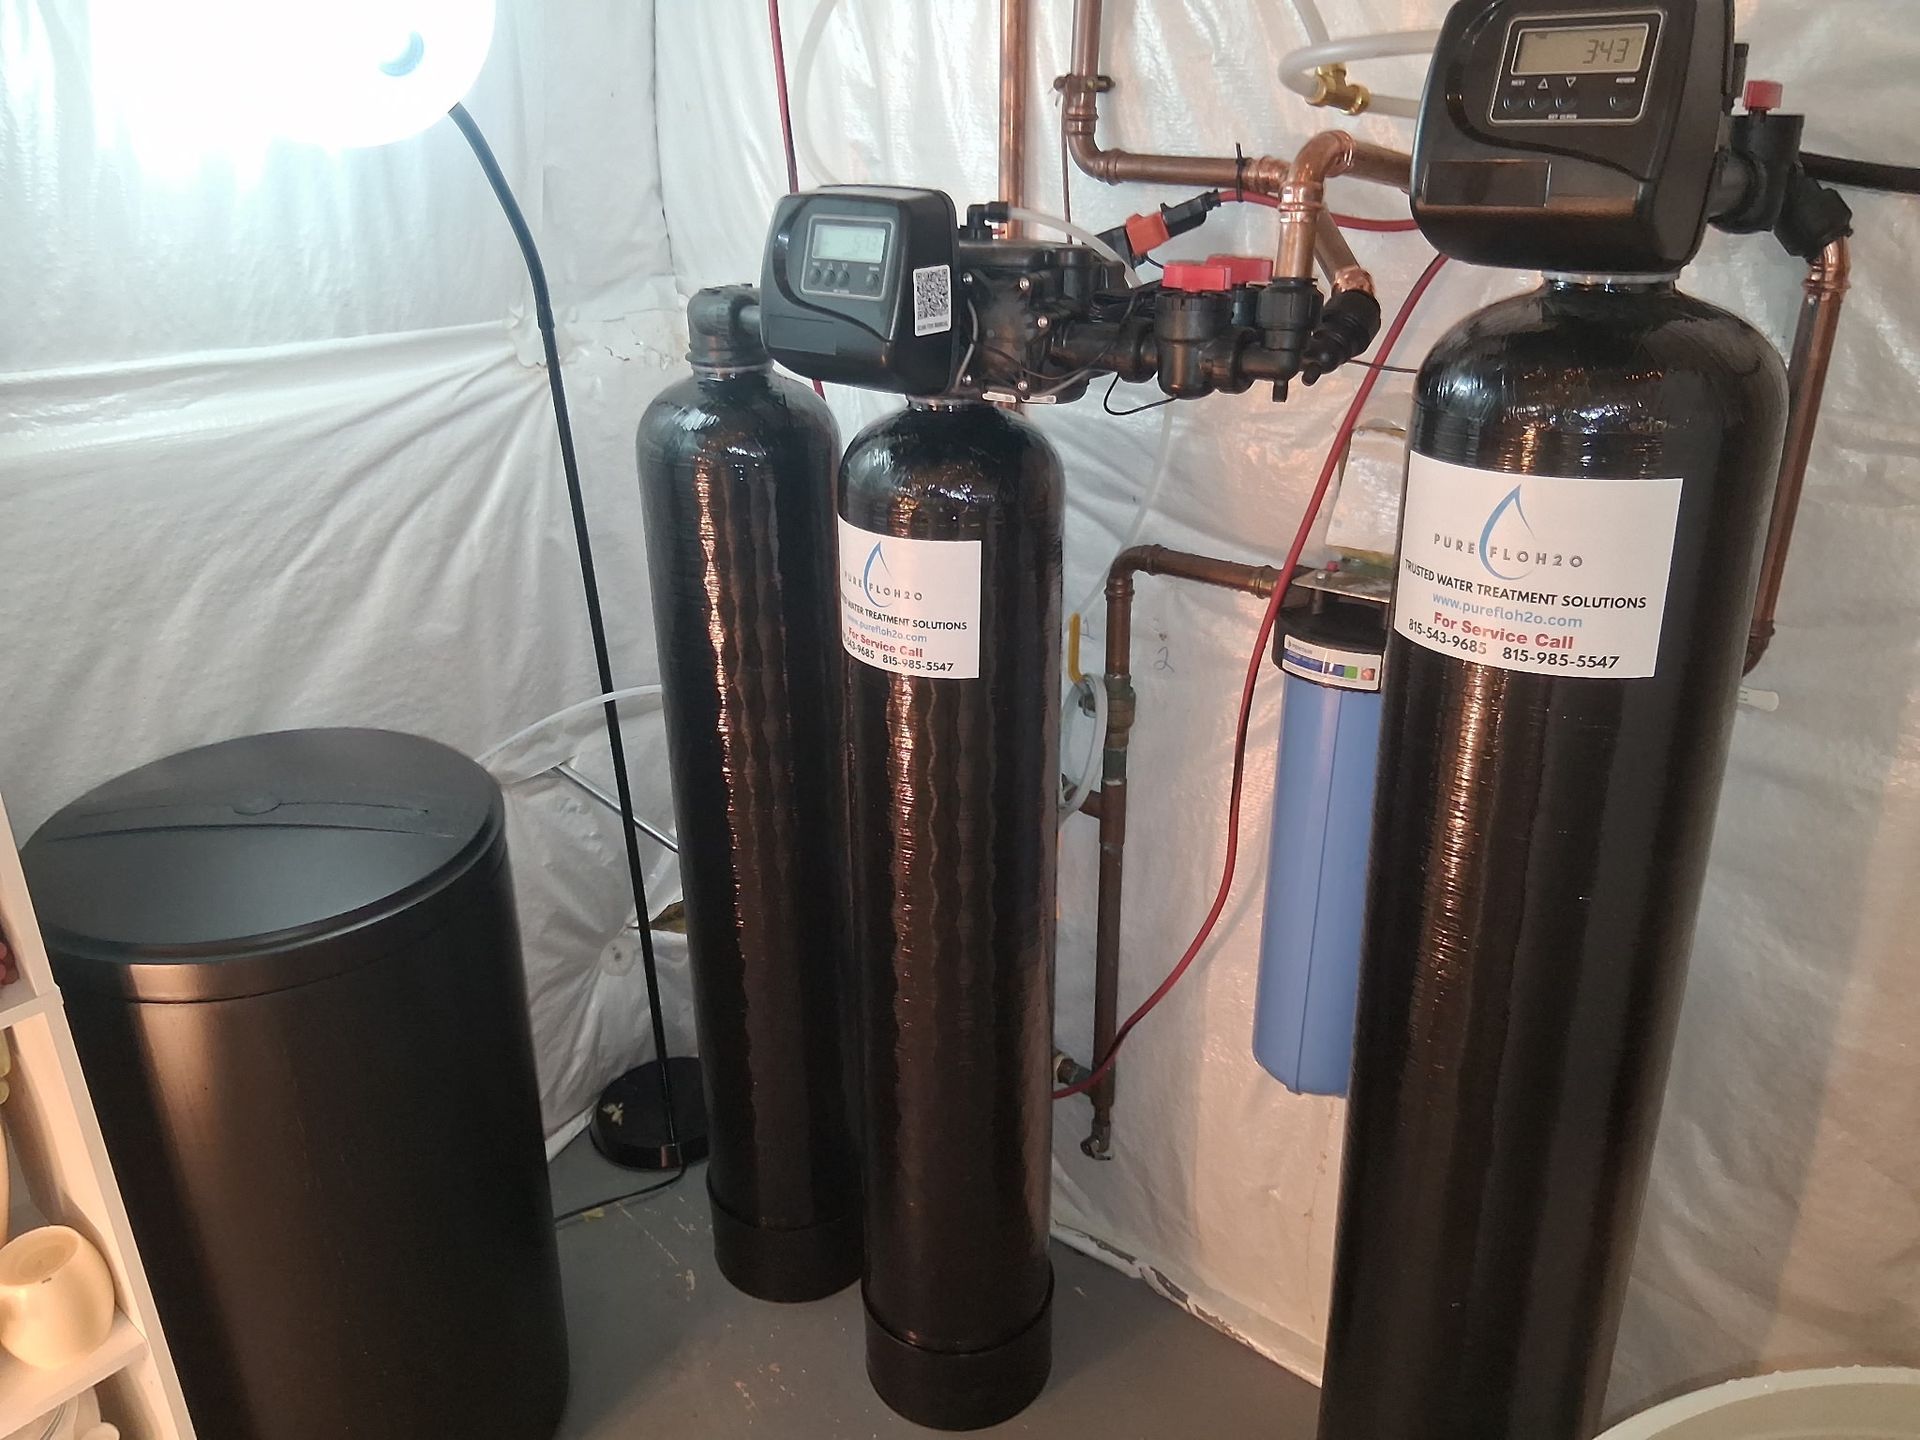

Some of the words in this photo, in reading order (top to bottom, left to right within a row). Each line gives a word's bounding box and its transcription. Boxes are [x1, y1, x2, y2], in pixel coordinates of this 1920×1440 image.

[1582, 38, 1629, 64] 343
[1434, 533, 1475, 555] PURE
[1490, 547, 1583, 568] FLOH2O
[869, 582, 923, 601] FLOH2O
[1405, 559, 1434, 581] TRUSTED
[1437, 573, 1473, 593] WATER
[1477, 583, 1557, 606] TREATMENT
[1562, 595, 1647, 609] SOLUTIONS
[865, 608, 910, 626] TREATMENT
[913, 620, 968, 630] SOLUTIONS
[1432, 593, 1583, 628] www.purefloh2o.com
[849, 626, 859, 640] For
[861, 634, 896, 653] Service
[900, 645, 923, 658] Call
[1408, 618, 1487, 655] 815-543-9685
[1502, 647, 1620, 669] 815-985-5547
[1434, 612, 1456, 630] For
[1461, 621, 1528, 644] Service
[1535, 633, 1574, 650] Call
[842, 631, 875, 660] -43-9685
[882, 654, 954, 672] 815-985-5547
